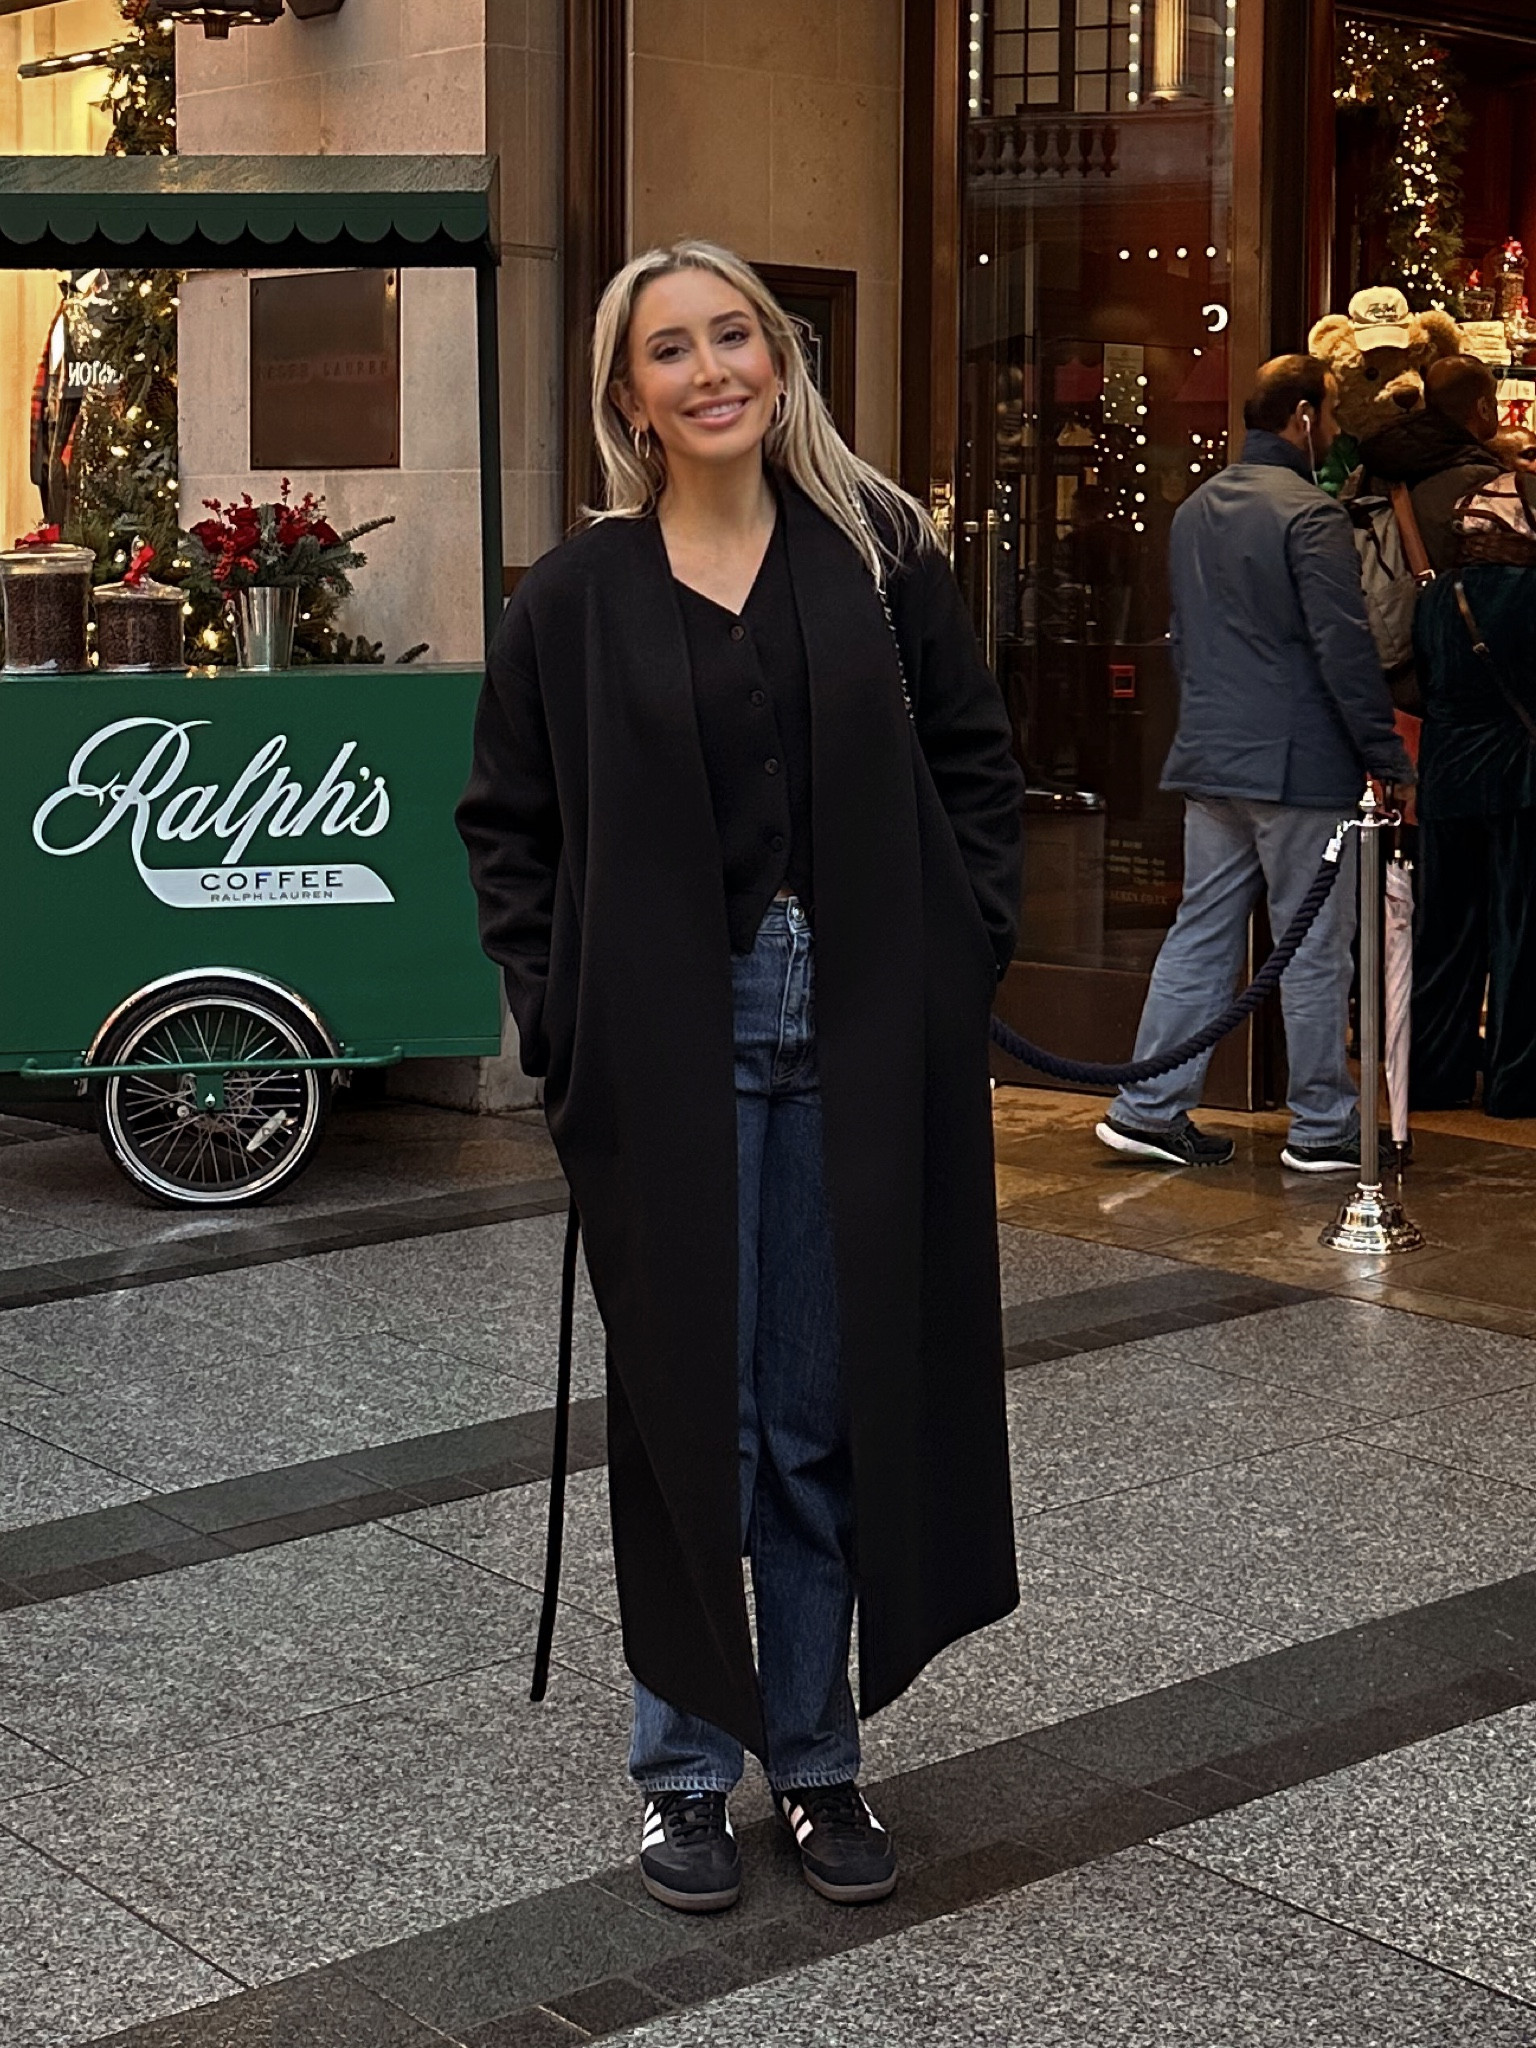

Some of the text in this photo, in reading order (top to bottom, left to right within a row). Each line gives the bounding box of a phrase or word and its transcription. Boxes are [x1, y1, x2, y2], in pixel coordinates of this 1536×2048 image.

[32, 716, 391, 865] Ralph's
[200, 869, 344, 891] COFFEE
[210, 890, 333, 903] RALPH LAUREN
